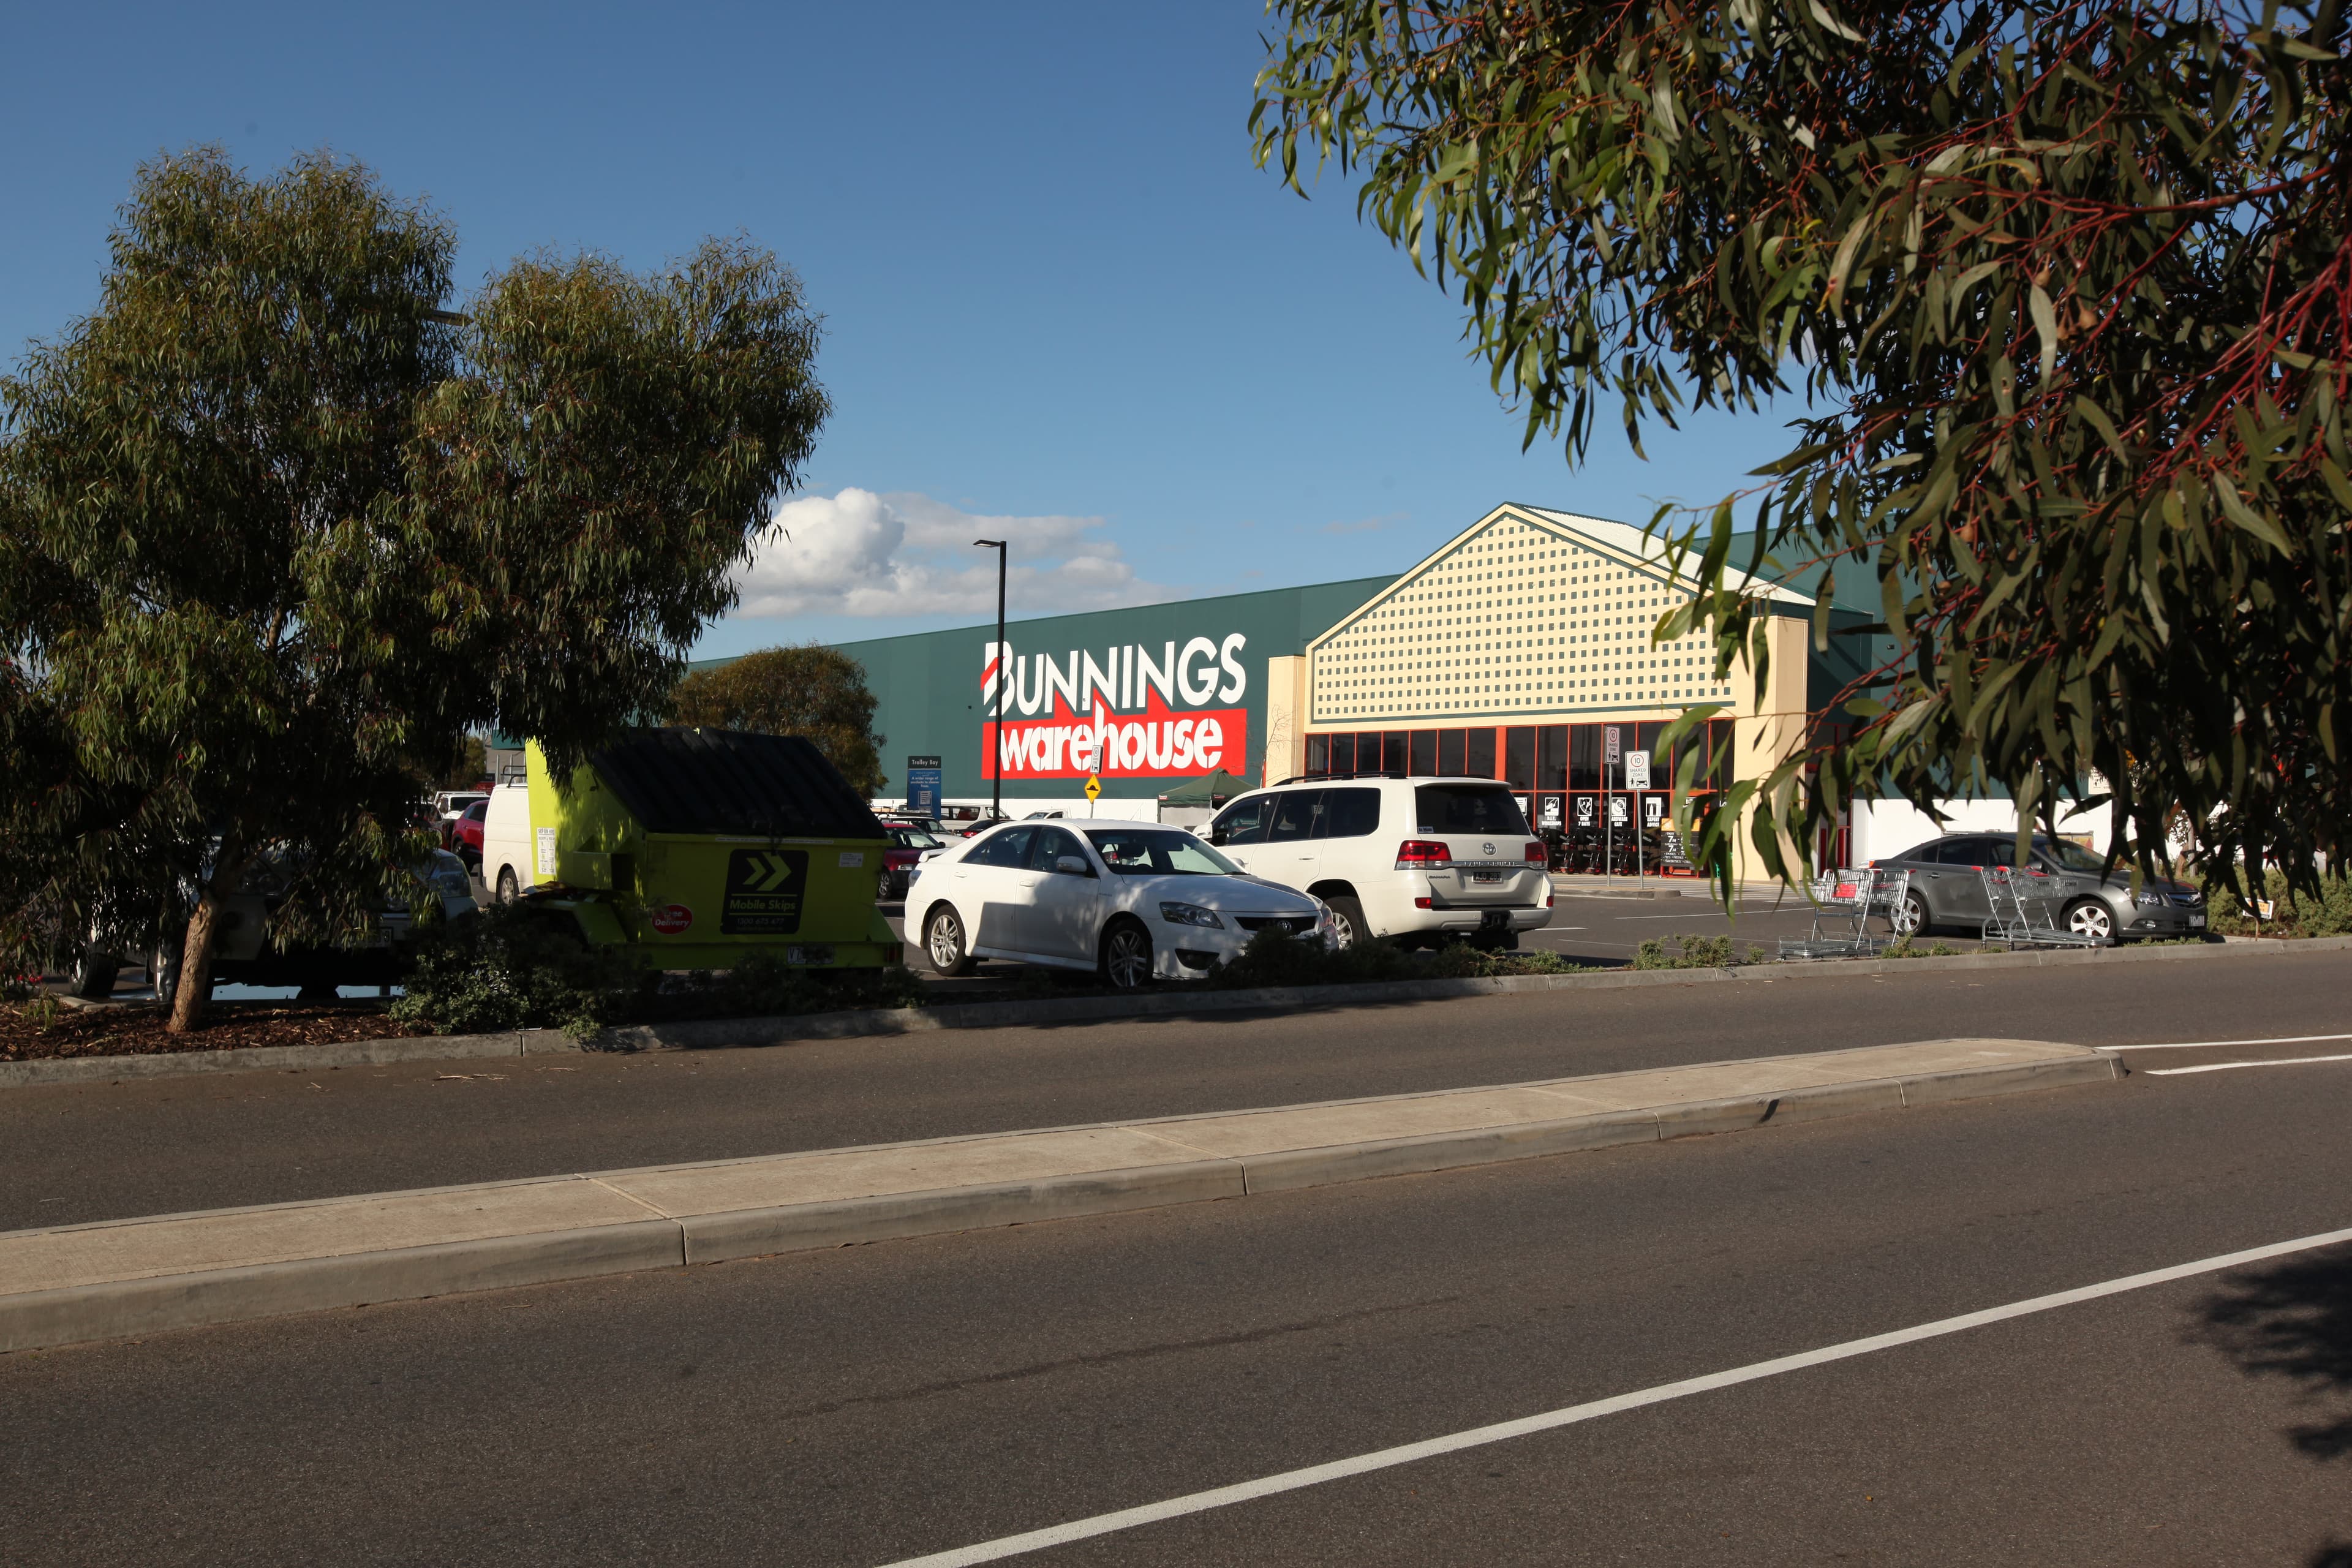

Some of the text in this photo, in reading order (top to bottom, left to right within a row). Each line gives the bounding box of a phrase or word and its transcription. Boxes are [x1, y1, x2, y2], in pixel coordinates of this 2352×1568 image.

[982, 633, 1246, 717] BUNNINGS
[1000, 699, 1223, 772] warehouse
[655, 918, 689, 928] Delivery
[729, 899, 796, 913] Mobile Skips
